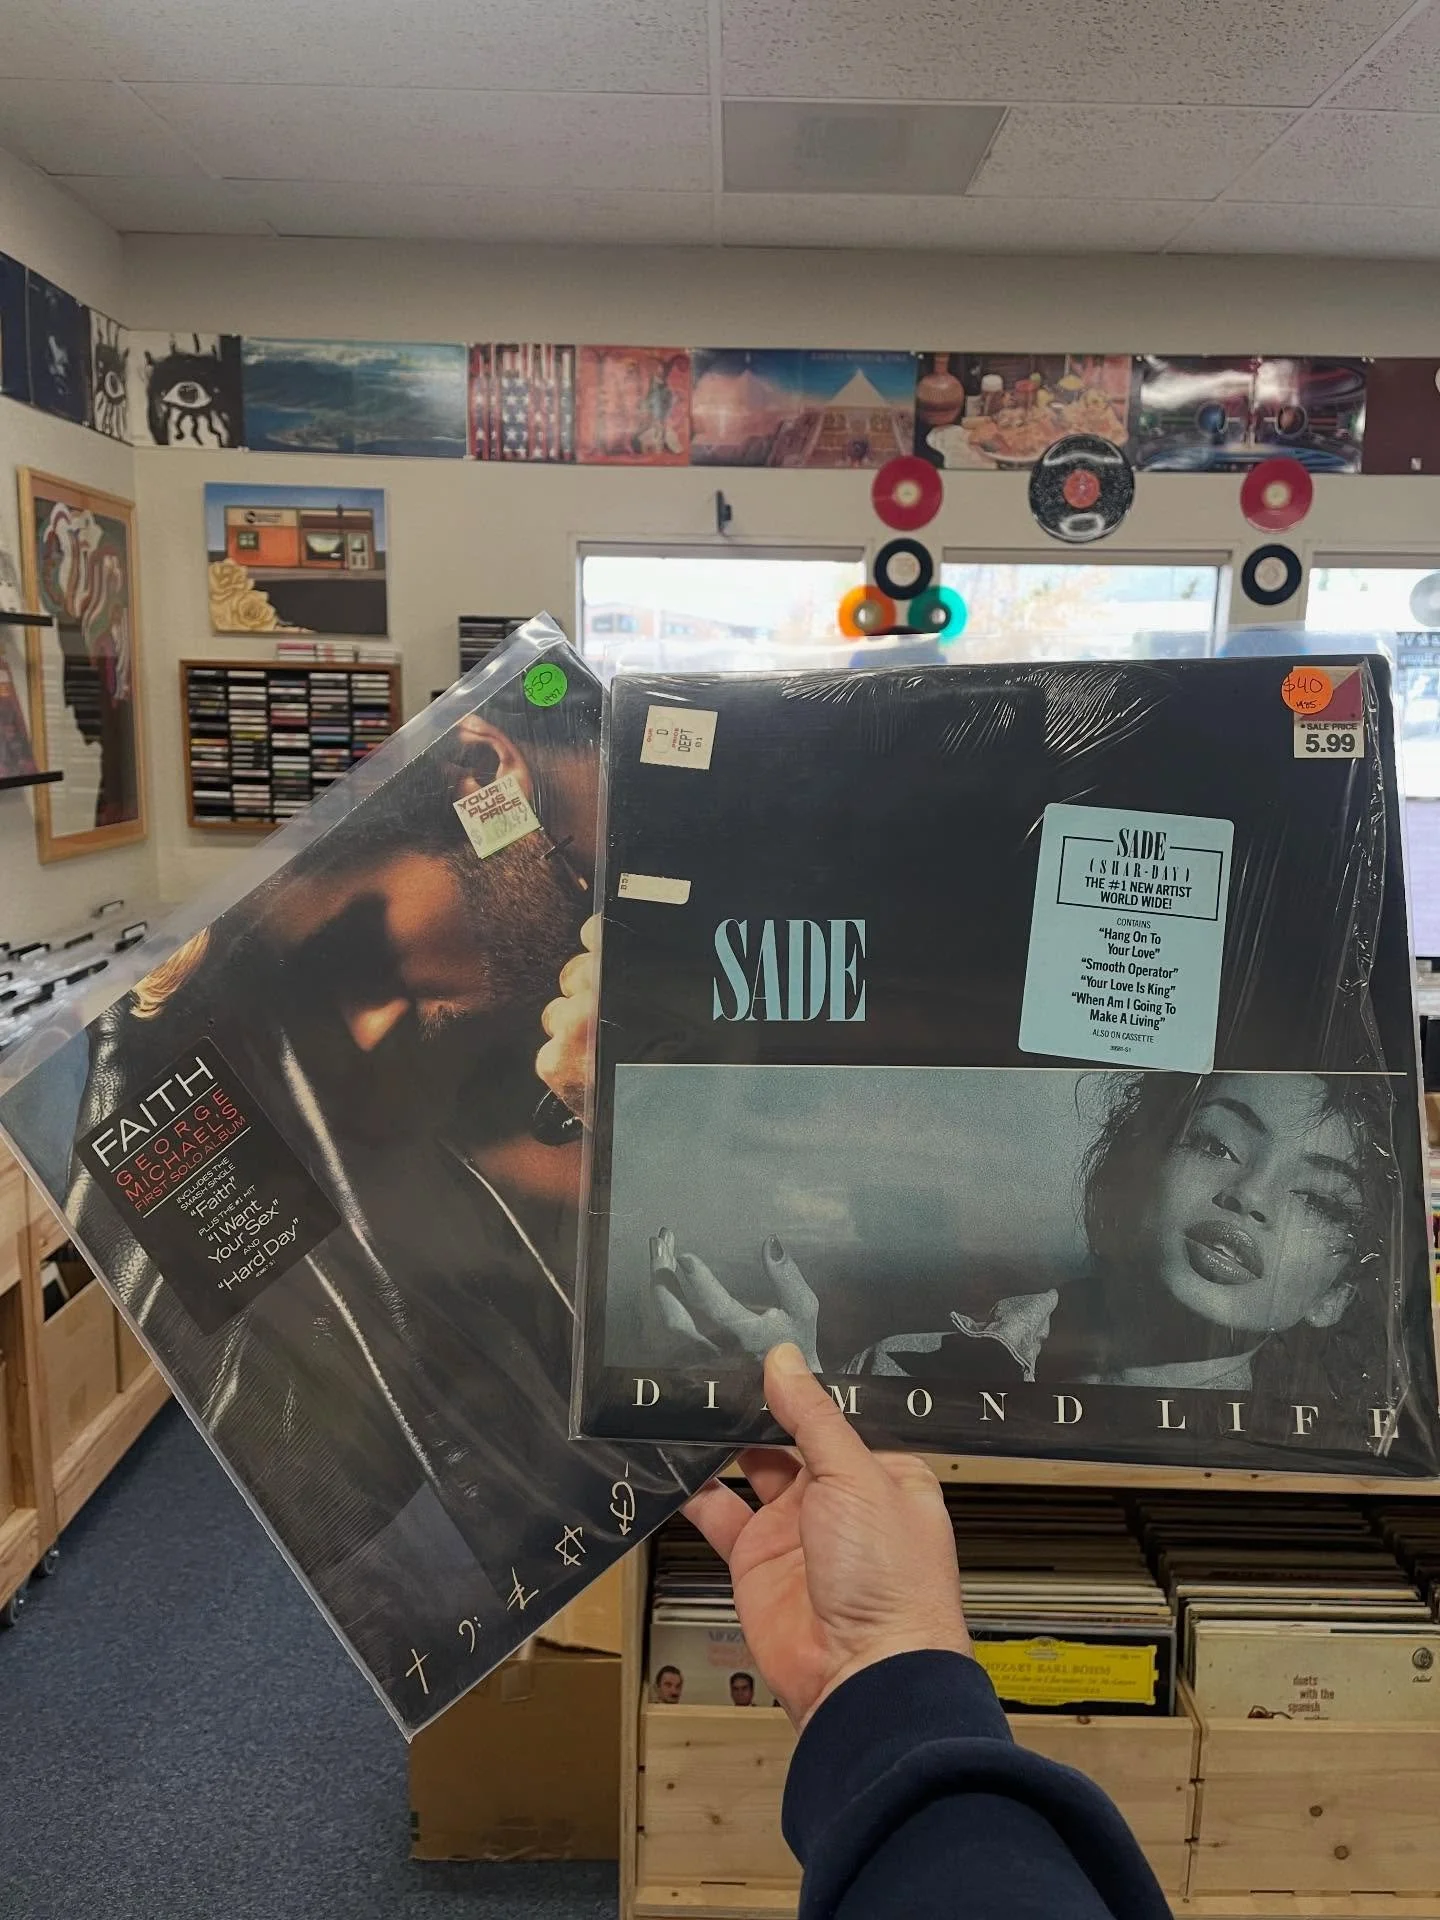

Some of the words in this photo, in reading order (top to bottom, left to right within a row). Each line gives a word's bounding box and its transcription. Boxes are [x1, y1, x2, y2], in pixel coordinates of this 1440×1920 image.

[525, 671, 553, 701] $50
[1283, 675, 1323, 701] $40
[646, 727, 654, 743] OUR
[671, 727, 680, 749] PRICE
[1306, 723, 1330, 731] SALE
[1331, 722, 1358, 731] PRICE
[677, 728, 693, 753] DEPT
[1305, 733, 1356, 753] 5.99
[457, 785, 499, 810] YOUR
[468, 793, 506, 818] PLUS
[479, 796, 522, 824] PRICE
[1116, 827, 1167, 861] SADE
[1084, 876, 1105, 889] THE
[1108, 880, 1126, 892] #1
[1129, 881, 1154, 894] NEW
[1155, 884, 1193, 898] ARTIST
[1100, 890, 1138, 906] WORLD
[1141, 894, 1173, 910] WIDE!
[1116, 917, 1151, 929] CONTAINS
[1099, 927, 1130, 944] “Hang
[1132, 931, 1148, 943] On
[1150, 932, 1162, 945] To
[1107, 943, 1130, 957] Your
[1131, 946, 1161, 959] Love”
[713, 918, 866, 1022] SADE
[1081, 957, 1126, 974] “Smooth
[1128, 963, 1179, 979] Operator”
[1080, 975, 1108, 989] “Your
[1110, 979, 1134, 992] Love
[1136, 981, 1145, 993] Is
[1147, 982, 1176, 999] King”
[1071, 991, 1105, 1007] “When
[1106, 996, 1124, 1009] Am
[1126, 998, 1131, 1010] I
[1133, 999, 1162, 1016] Going
[1164, 1002, 1177, 1015] To
[1089, 1009, 1118, 1024] Make
[1119, 1013, 1128, 1025] A
[1129, 1014, 1166, 1031] Living”
[1092, 1029, 1110, 1038] ALSO
[1110, 1030, 1121, 1039] ON
[1121, 1032, 1154, 1043] CASSETTE
[91, 1056, 214, 1168] FAITH
[116, 1088, 230, 1186] GEORGE
[125, 1103, 237, 1202] MICHAEL'S
[134, 1180, 169, 1212] FIRST
[170, 1152, 203, 1183] SOLO
[204, 1115, 246, 1156] ALBUM
[176, 1170, 214, 1203] INCLUDES
[212, 1156, 230, 1172] THE
[180, 1186, 209, 1211] SMASH
[207, 1162, 236, 1188] SINGLE
[190, 1175, 237, 1218] “Faith”
[198, 1216, 220, 1237] PLUS
[218, 1203, 236, 1218] THE
[235, 1196, 244, 1206] #1
[243, 1184, 256, 1198] HIT
[219, 1200, 263, 1236] Want
[207, 1232, 244, 1264] Your
[244, 1198, 280, 1236] Sex”
[217, 1250, 266, 1291] “Hard
[263, 1217, 299, 1256] Day”
[243, 1238, 260, 1255] AND
[631, 1377, 1084, 1425] DIMOND
[1156, 1399, 1400, 1440] LIFE
[1293, 1674, 1319, 1686] duets
[1300, 1688, 1318, 1699] with
[1320, 1688, 1335, 1699] the
[1287, 1702, 1321, 1714] spanish
